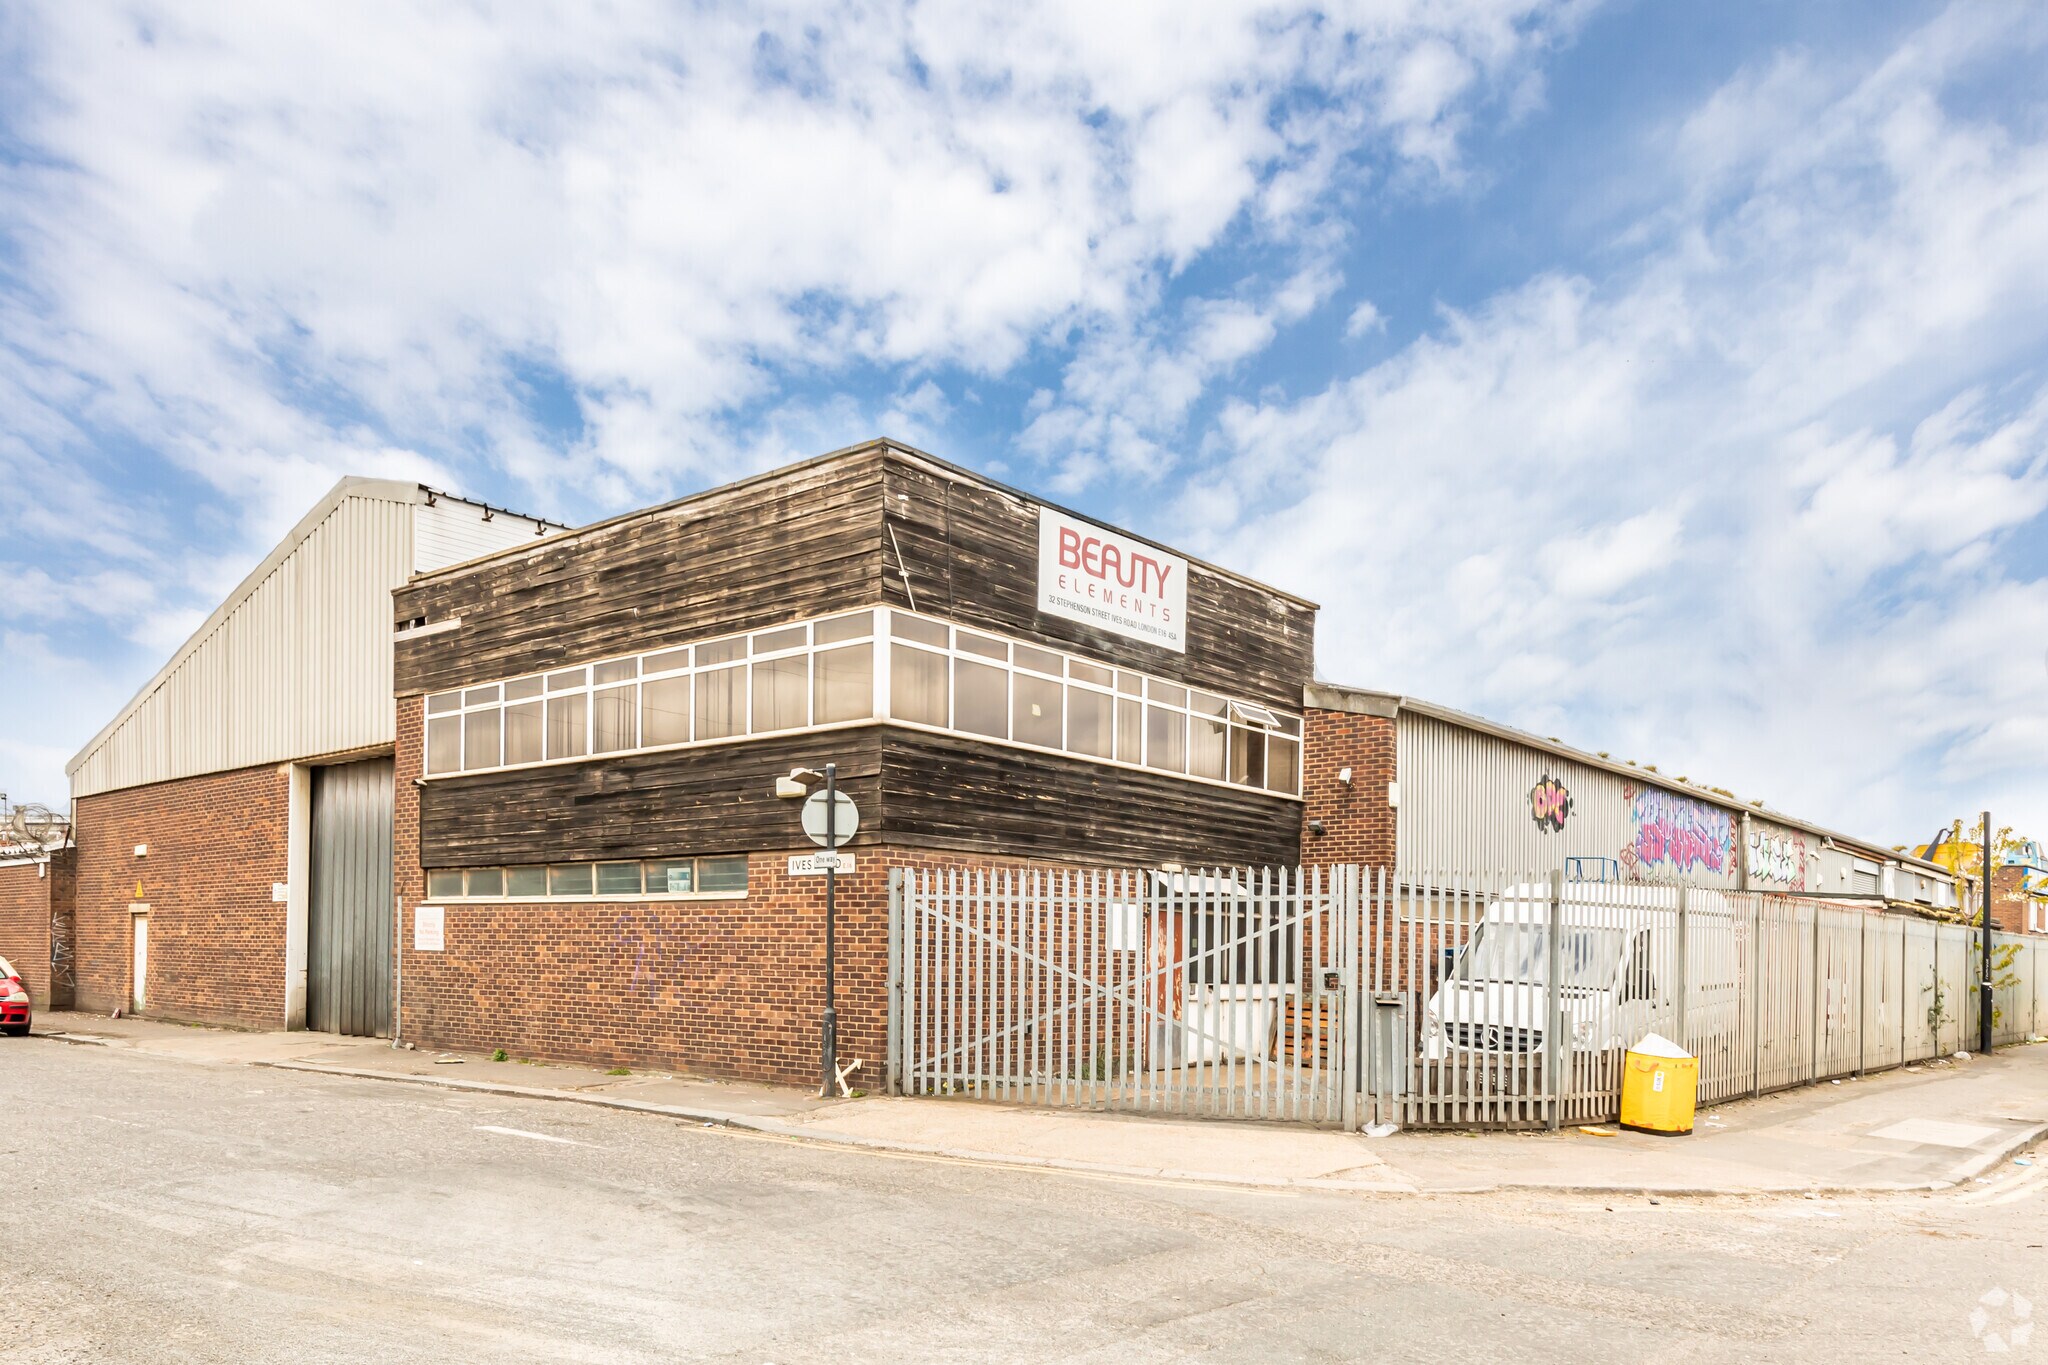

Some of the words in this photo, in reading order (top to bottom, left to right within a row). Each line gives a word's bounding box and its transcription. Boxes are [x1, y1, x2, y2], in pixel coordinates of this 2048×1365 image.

[1059, 526, 1172, 599] BEAUTY
[1048, 594, 1056, 604] 32
[1056, 597, 1091, 615] STEPHENSON
[1091, 607, 1110, 620] STREET
[1111, 614, 1123, 625] IVES
[1123, 617, 1137, 629] ROAD
[1138, 621, 1158, 635] LONDON
[1058, 574, 1171, 622] ELEMENTS
[792, 860, 812, 870] IVES
